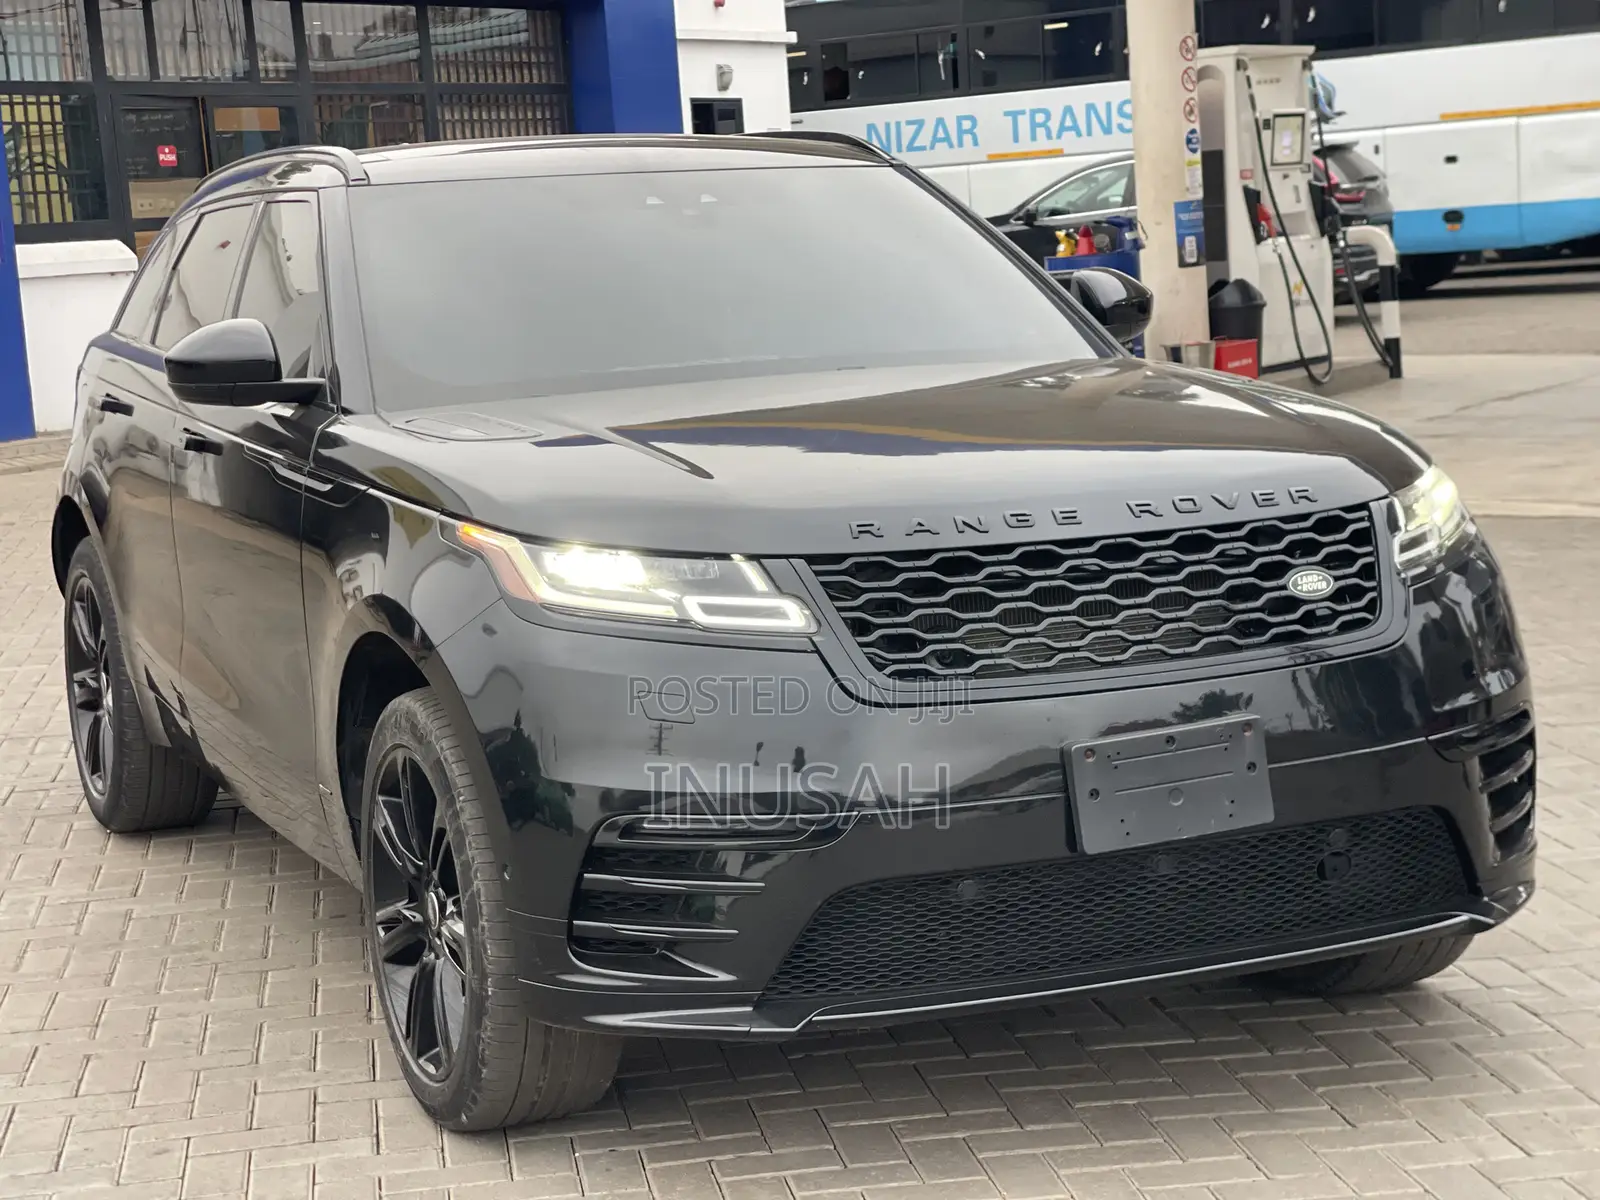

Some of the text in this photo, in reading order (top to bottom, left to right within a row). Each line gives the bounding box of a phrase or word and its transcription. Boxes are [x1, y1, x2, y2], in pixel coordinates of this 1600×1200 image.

[866, 98, 1133, 154] NIZAR TRANS
[849, 486, 1318, 539] RANGE ROVER
[1297, 574, 1318, 585] LAND
[1302, 581, 1327, 592] ROVER
